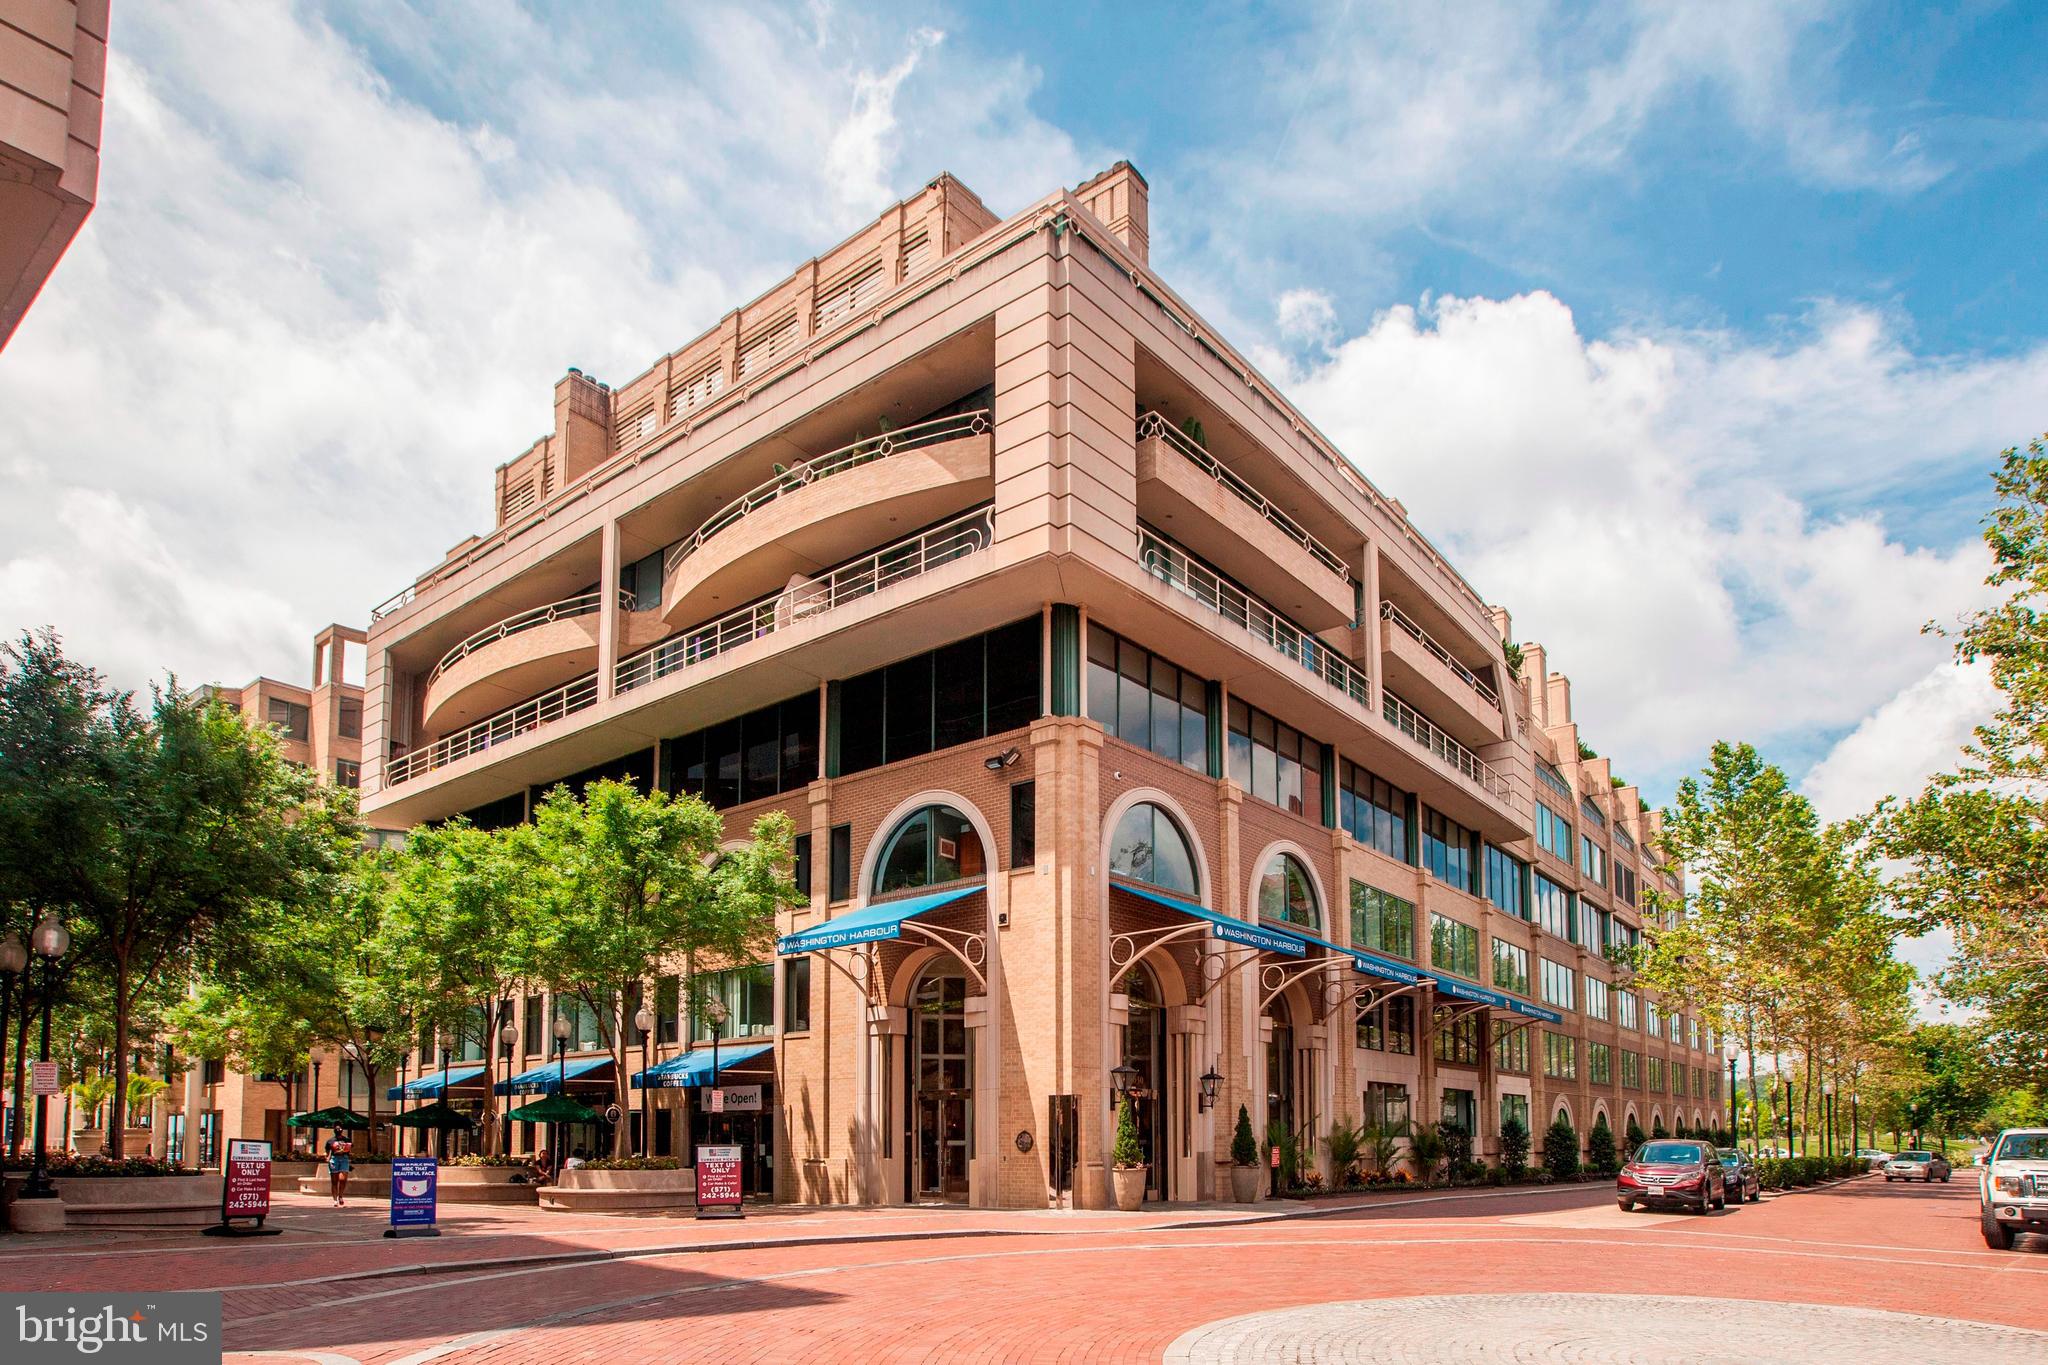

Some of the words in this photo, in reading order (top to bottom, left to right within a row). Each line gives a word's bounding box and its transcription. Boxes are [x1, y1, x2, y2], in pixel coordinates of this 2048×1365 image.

[786, 934, 846, 950] WASHINGTON
[849, 924, 898, 940] HARBOUR
[1223, 928, 1272, 946] WASHINGTON
[1273, 941, 1306, 953] HARBOUR
[1362, 962, 1395, 976] WASHINGTON
[1394, 971, 1418, 983] HARBOUR
[657, 1072, 689, 1080] STARBUCKS
[731, 1092, 757, 1106] Open!
[239, 1193, 259, 1201] (571)
[229, 1200, 268, 1209] 242-5944
